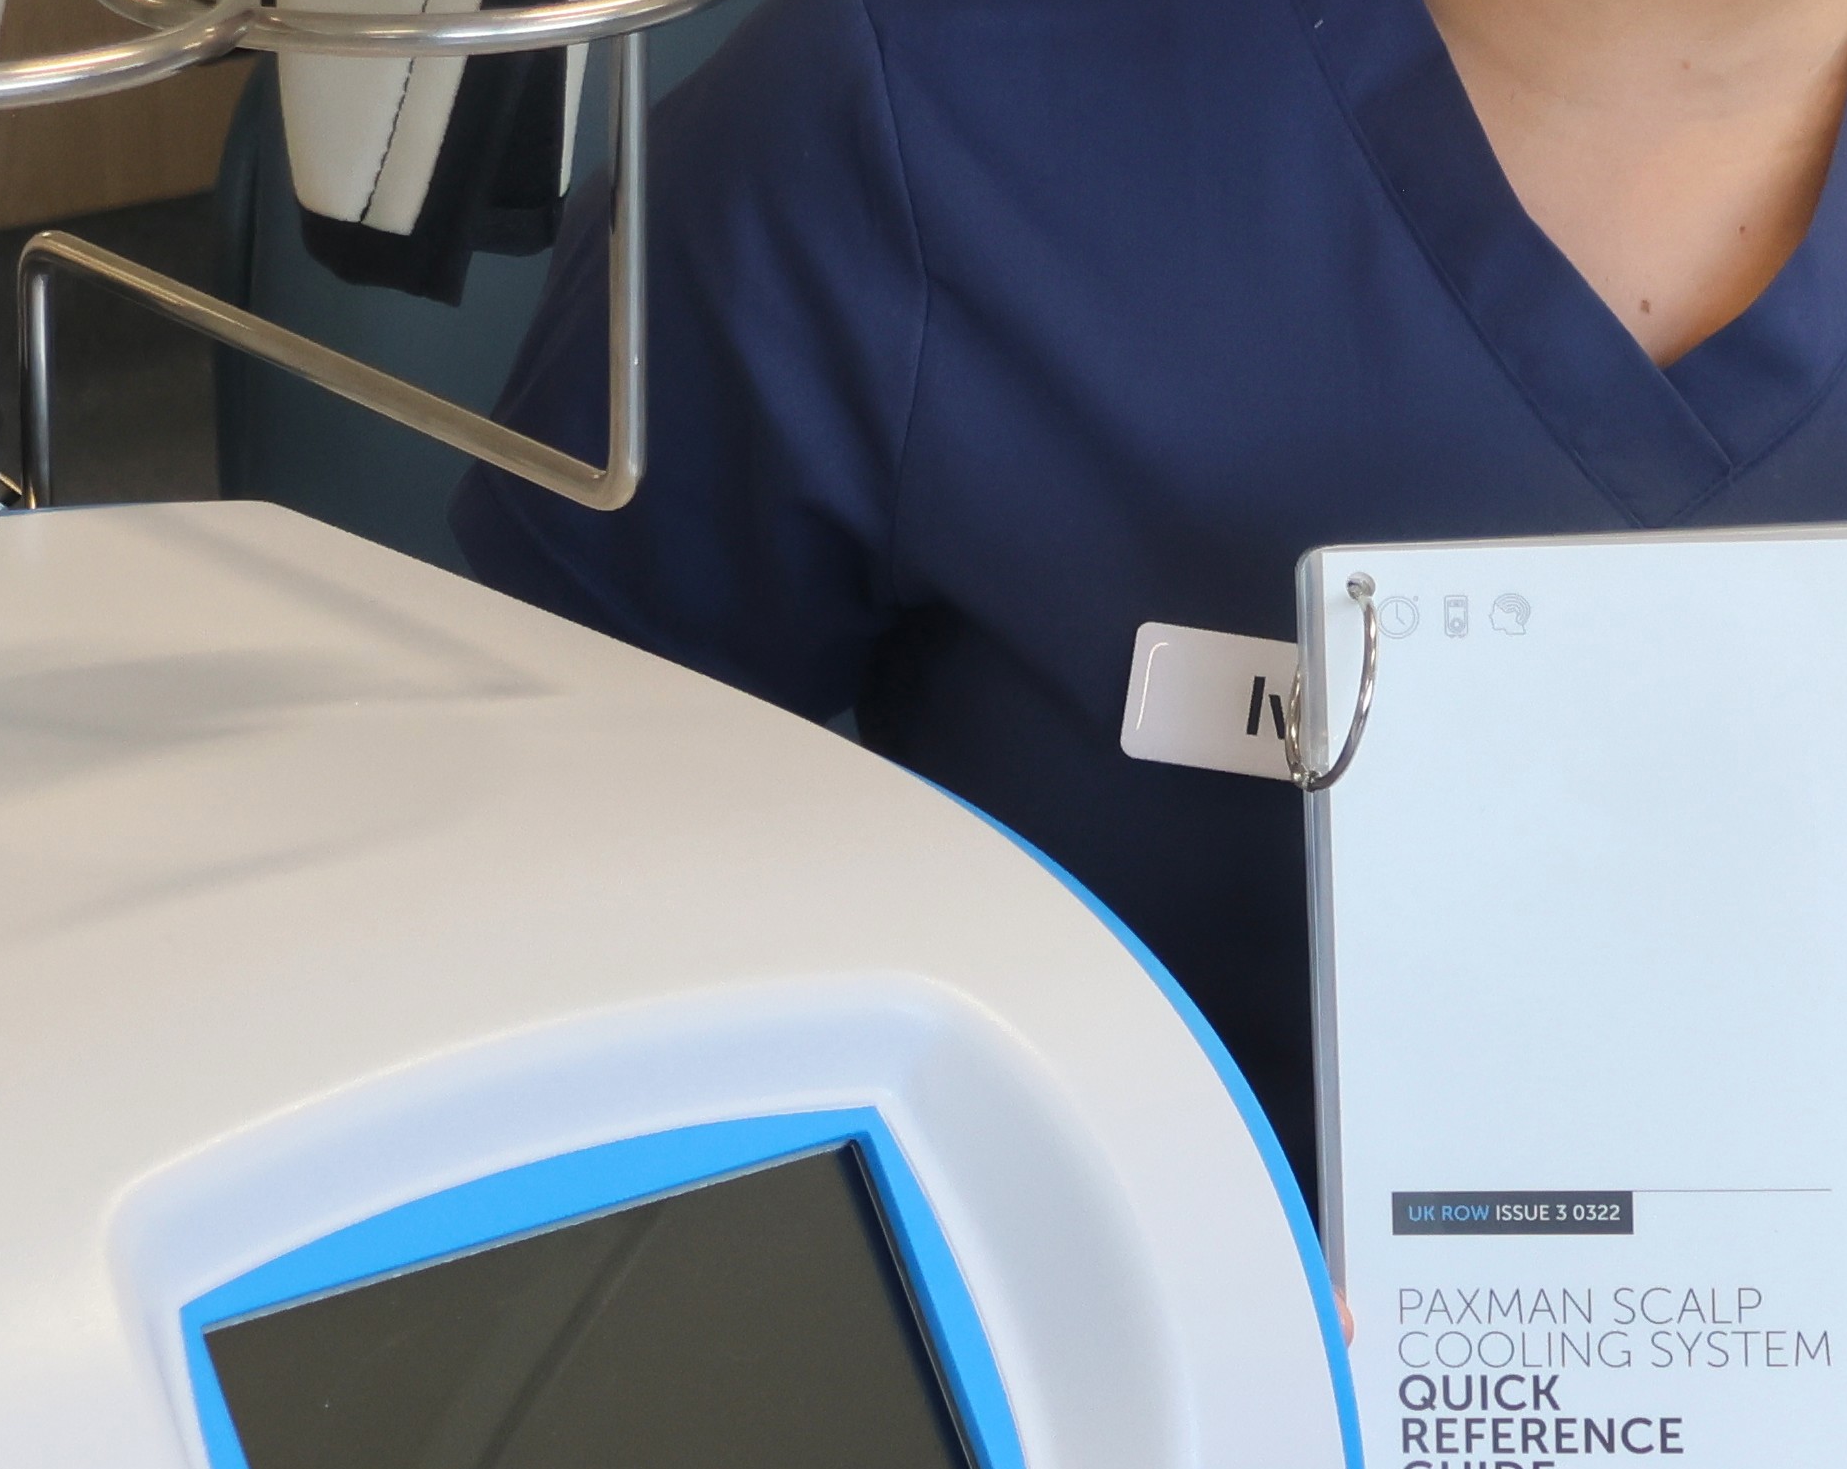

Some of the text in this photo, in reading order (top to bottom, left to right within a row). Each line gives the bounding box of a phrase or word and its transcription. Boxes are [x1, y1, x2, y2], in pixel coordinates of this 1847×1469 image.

[1408, 1204, 1621, 1221] UK ROW ISSUE 3 0322
[1398, 1287, 1763, 1325] PAXMAN SCALP
[1397, 1330, 1832, 1368] COOLING SYSTEM
[1398, 1374, 1562, 1412] QUICK
[1401, 1417, 1685, 1454] REFERENCE
